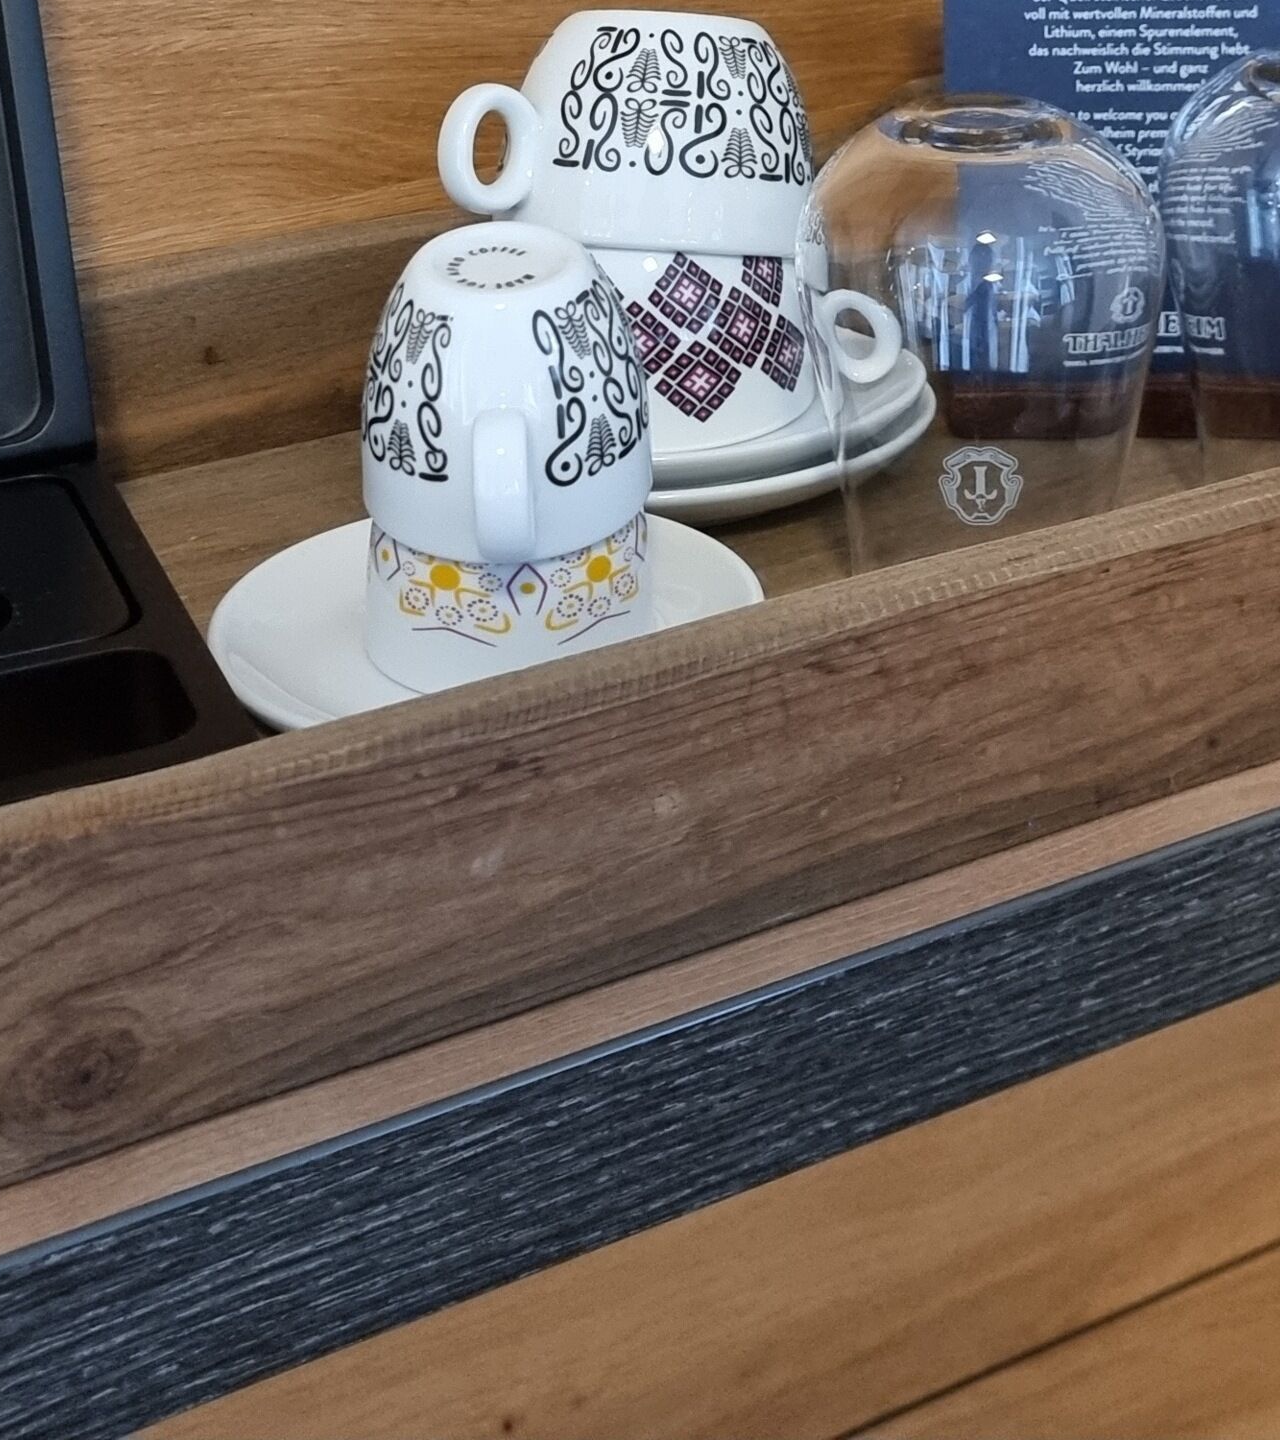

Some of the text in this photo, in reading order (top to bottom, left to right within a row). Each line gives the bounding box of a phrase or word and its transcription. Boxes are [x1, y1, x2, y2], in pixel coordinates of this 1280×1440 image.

[1023, 5, 1259, 20] voll mit wertvollen Mineralstoffen und
[1044, 24, 1239, 41] Lithium, einem Spurenelement,
[1028, 44, 1049, 57] das
[1052, 43, 1129, 56] nachweislich
[1131, 43, 1151, 56] die
[1153, 42, 1219, 60] Stimmung
[1073, 62, 1102, 75] Zum
[1105, 61, 1138, 74] Wohl
[1153, 61, 1178, 74] und
[1179, 64, 1209, 78] ganz
[1075, 80, 1124, 93] herzlich
[1093, 109, 1144, 121] welcome
